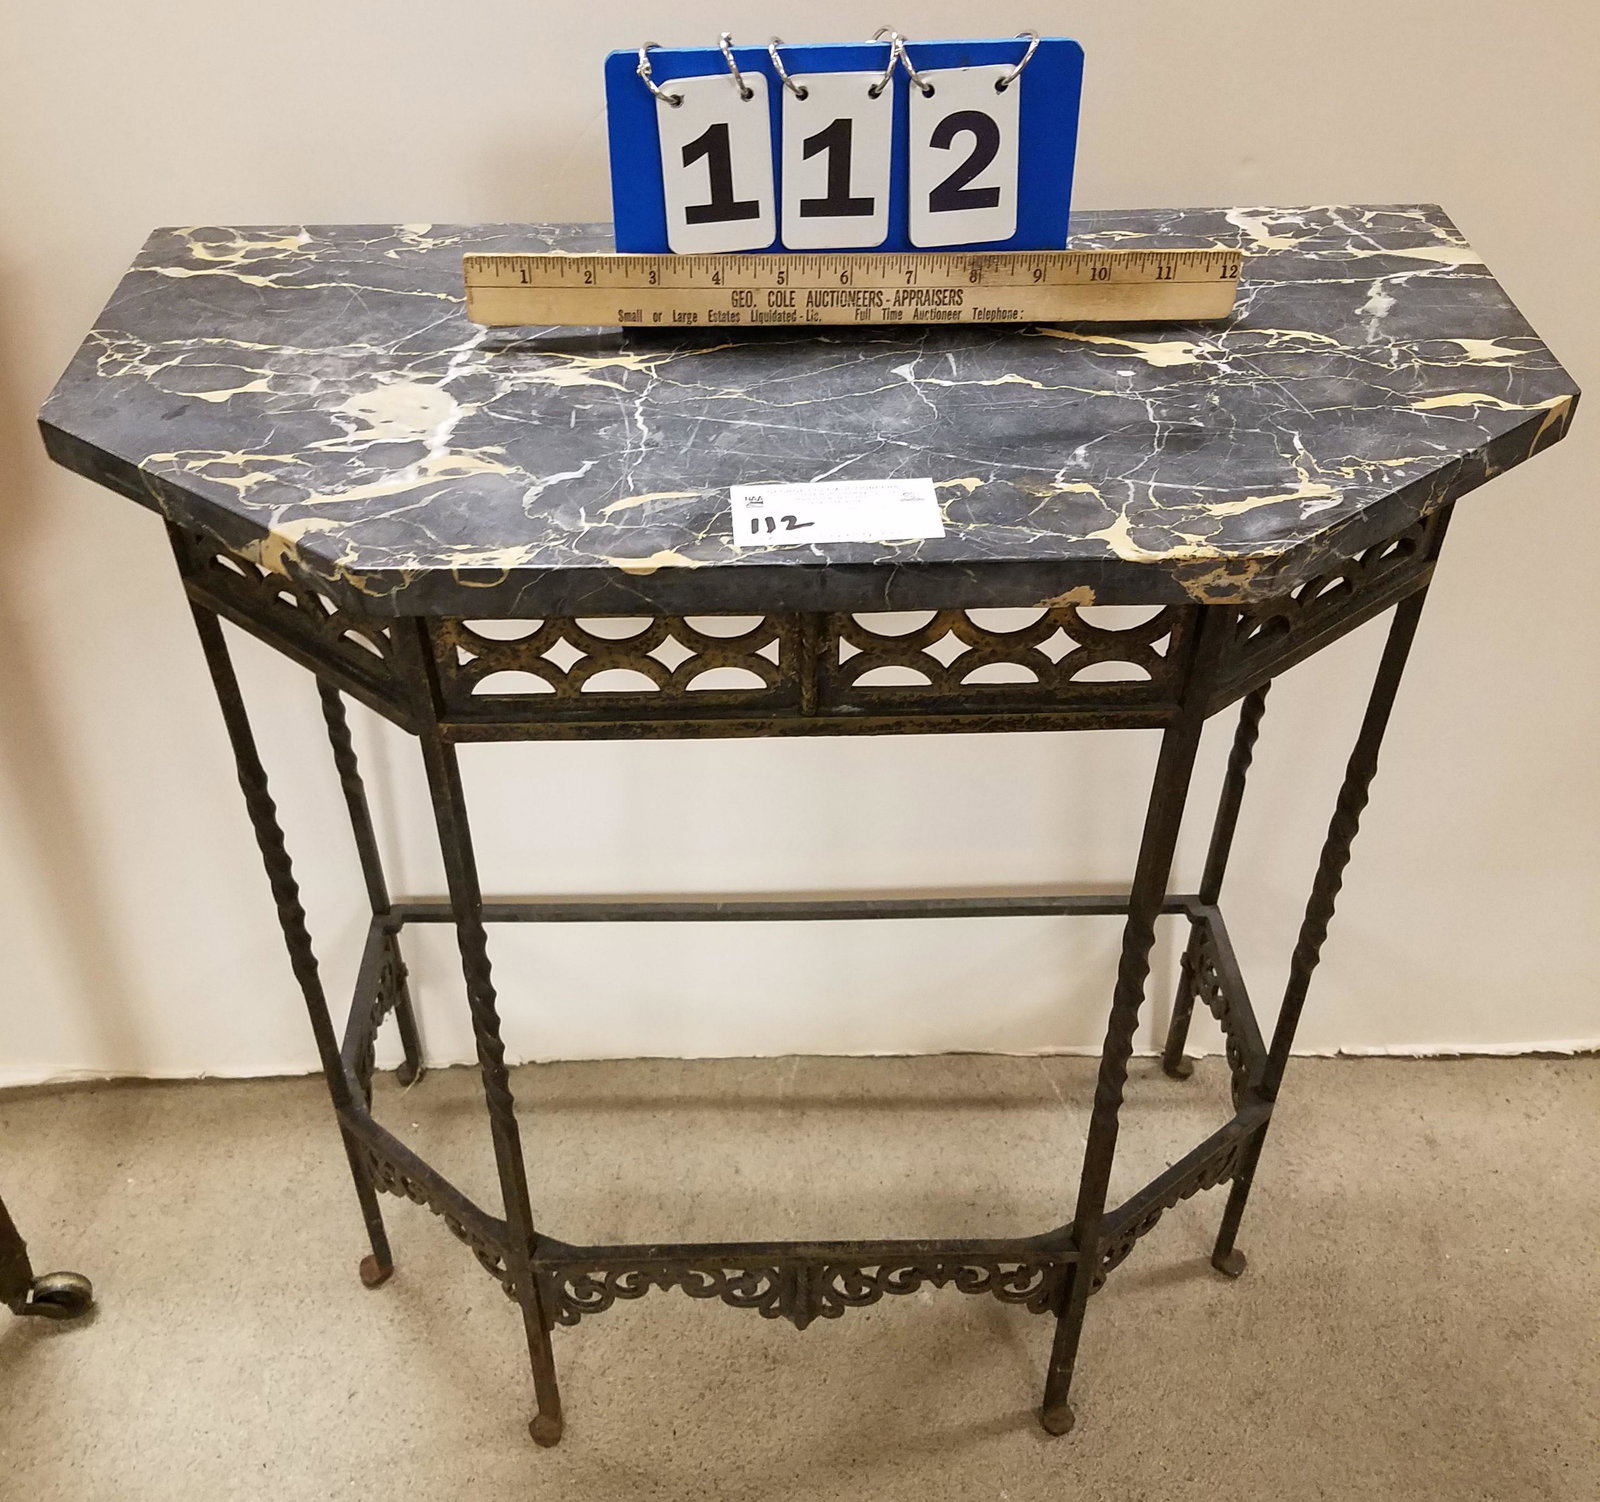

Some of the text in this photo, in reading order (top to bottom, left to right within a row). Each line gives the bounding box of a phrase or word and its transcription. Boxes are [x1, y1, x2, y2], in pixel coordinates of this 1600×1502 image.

[519, 264, 1238, 285] 1 2 3 4 5 6 7 8 9 10 11 12
[731, 290, 757, 308] GEO.
[767, 290, 796, 308] COLE
[618, 309, 643, 323] Small
[652, 311, 662, 323] or
[672, 309, 698, 325] Large
[708, 309, 741, 323] Estates
[854, 308, 871, 321] Full
[881, 308, 903, 321] Time
[912, 307, 962, 321] Auctioneer
[750, 515, 816, 534] 112
